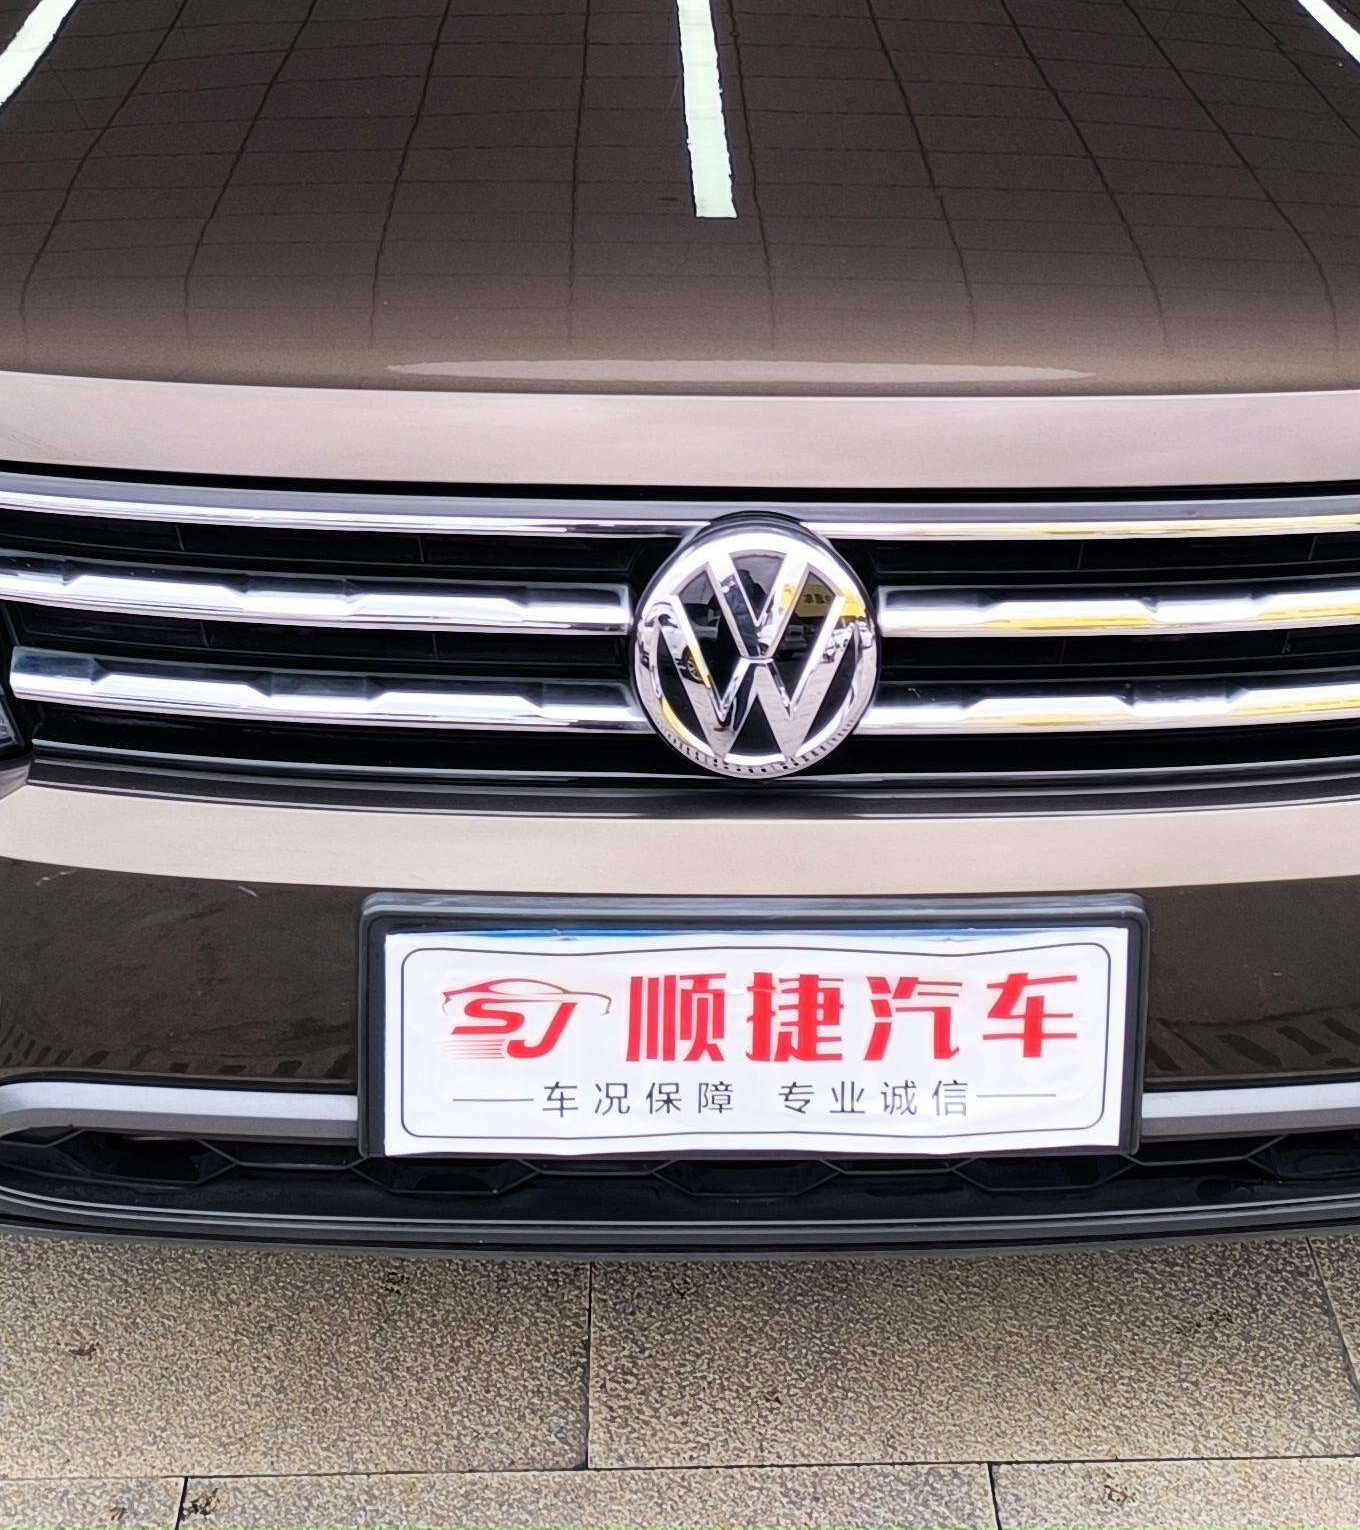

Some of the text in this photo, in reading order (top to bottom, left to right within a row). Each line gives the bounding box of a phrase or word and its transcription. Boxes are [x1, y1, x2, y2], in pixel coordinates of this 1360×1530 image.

[625, 971, 1079, 1064] 顺捷汽车
[542, 1077, 971, 1119] 车况保障 专业诚信
